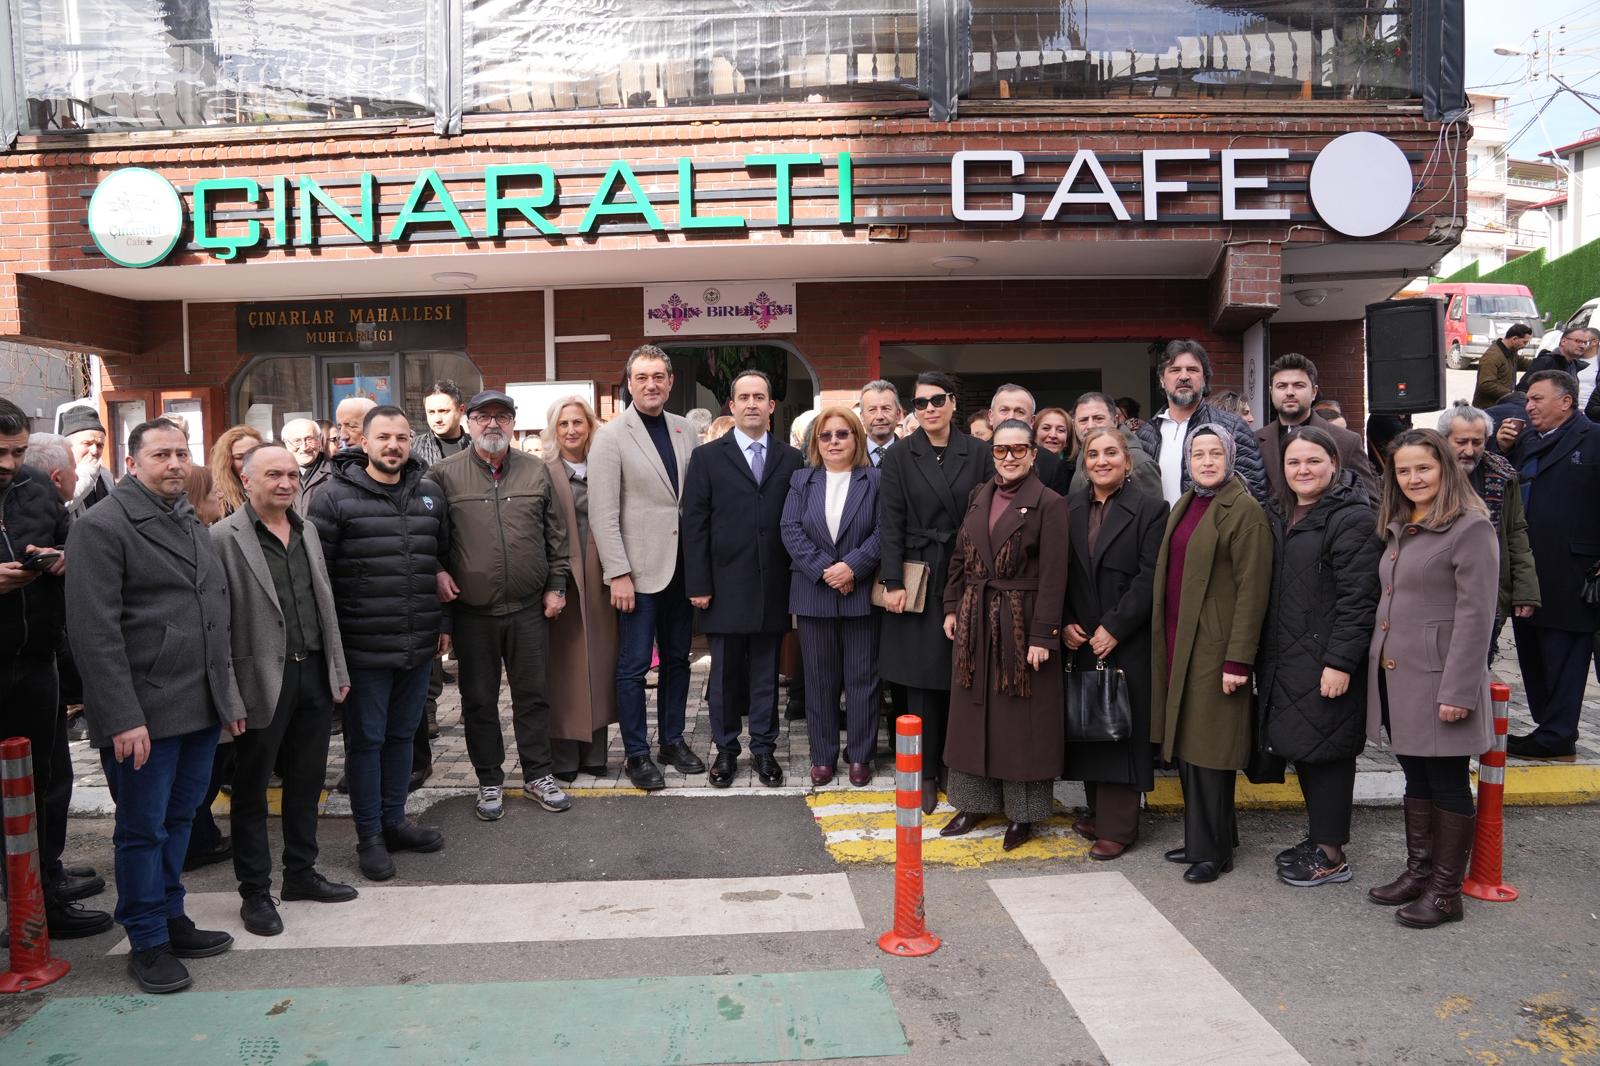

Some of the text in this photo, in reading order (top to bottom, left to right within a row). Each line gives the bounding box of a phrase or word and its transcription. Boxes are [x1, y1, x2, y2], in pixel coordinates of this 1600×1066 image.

[192, 148, 1292, 261] ÇINARALTI CAFE
[248, 303, 453, 329] ÇINARLAR MAHALLESİ
[648, 307, 700, 319] KADIN
